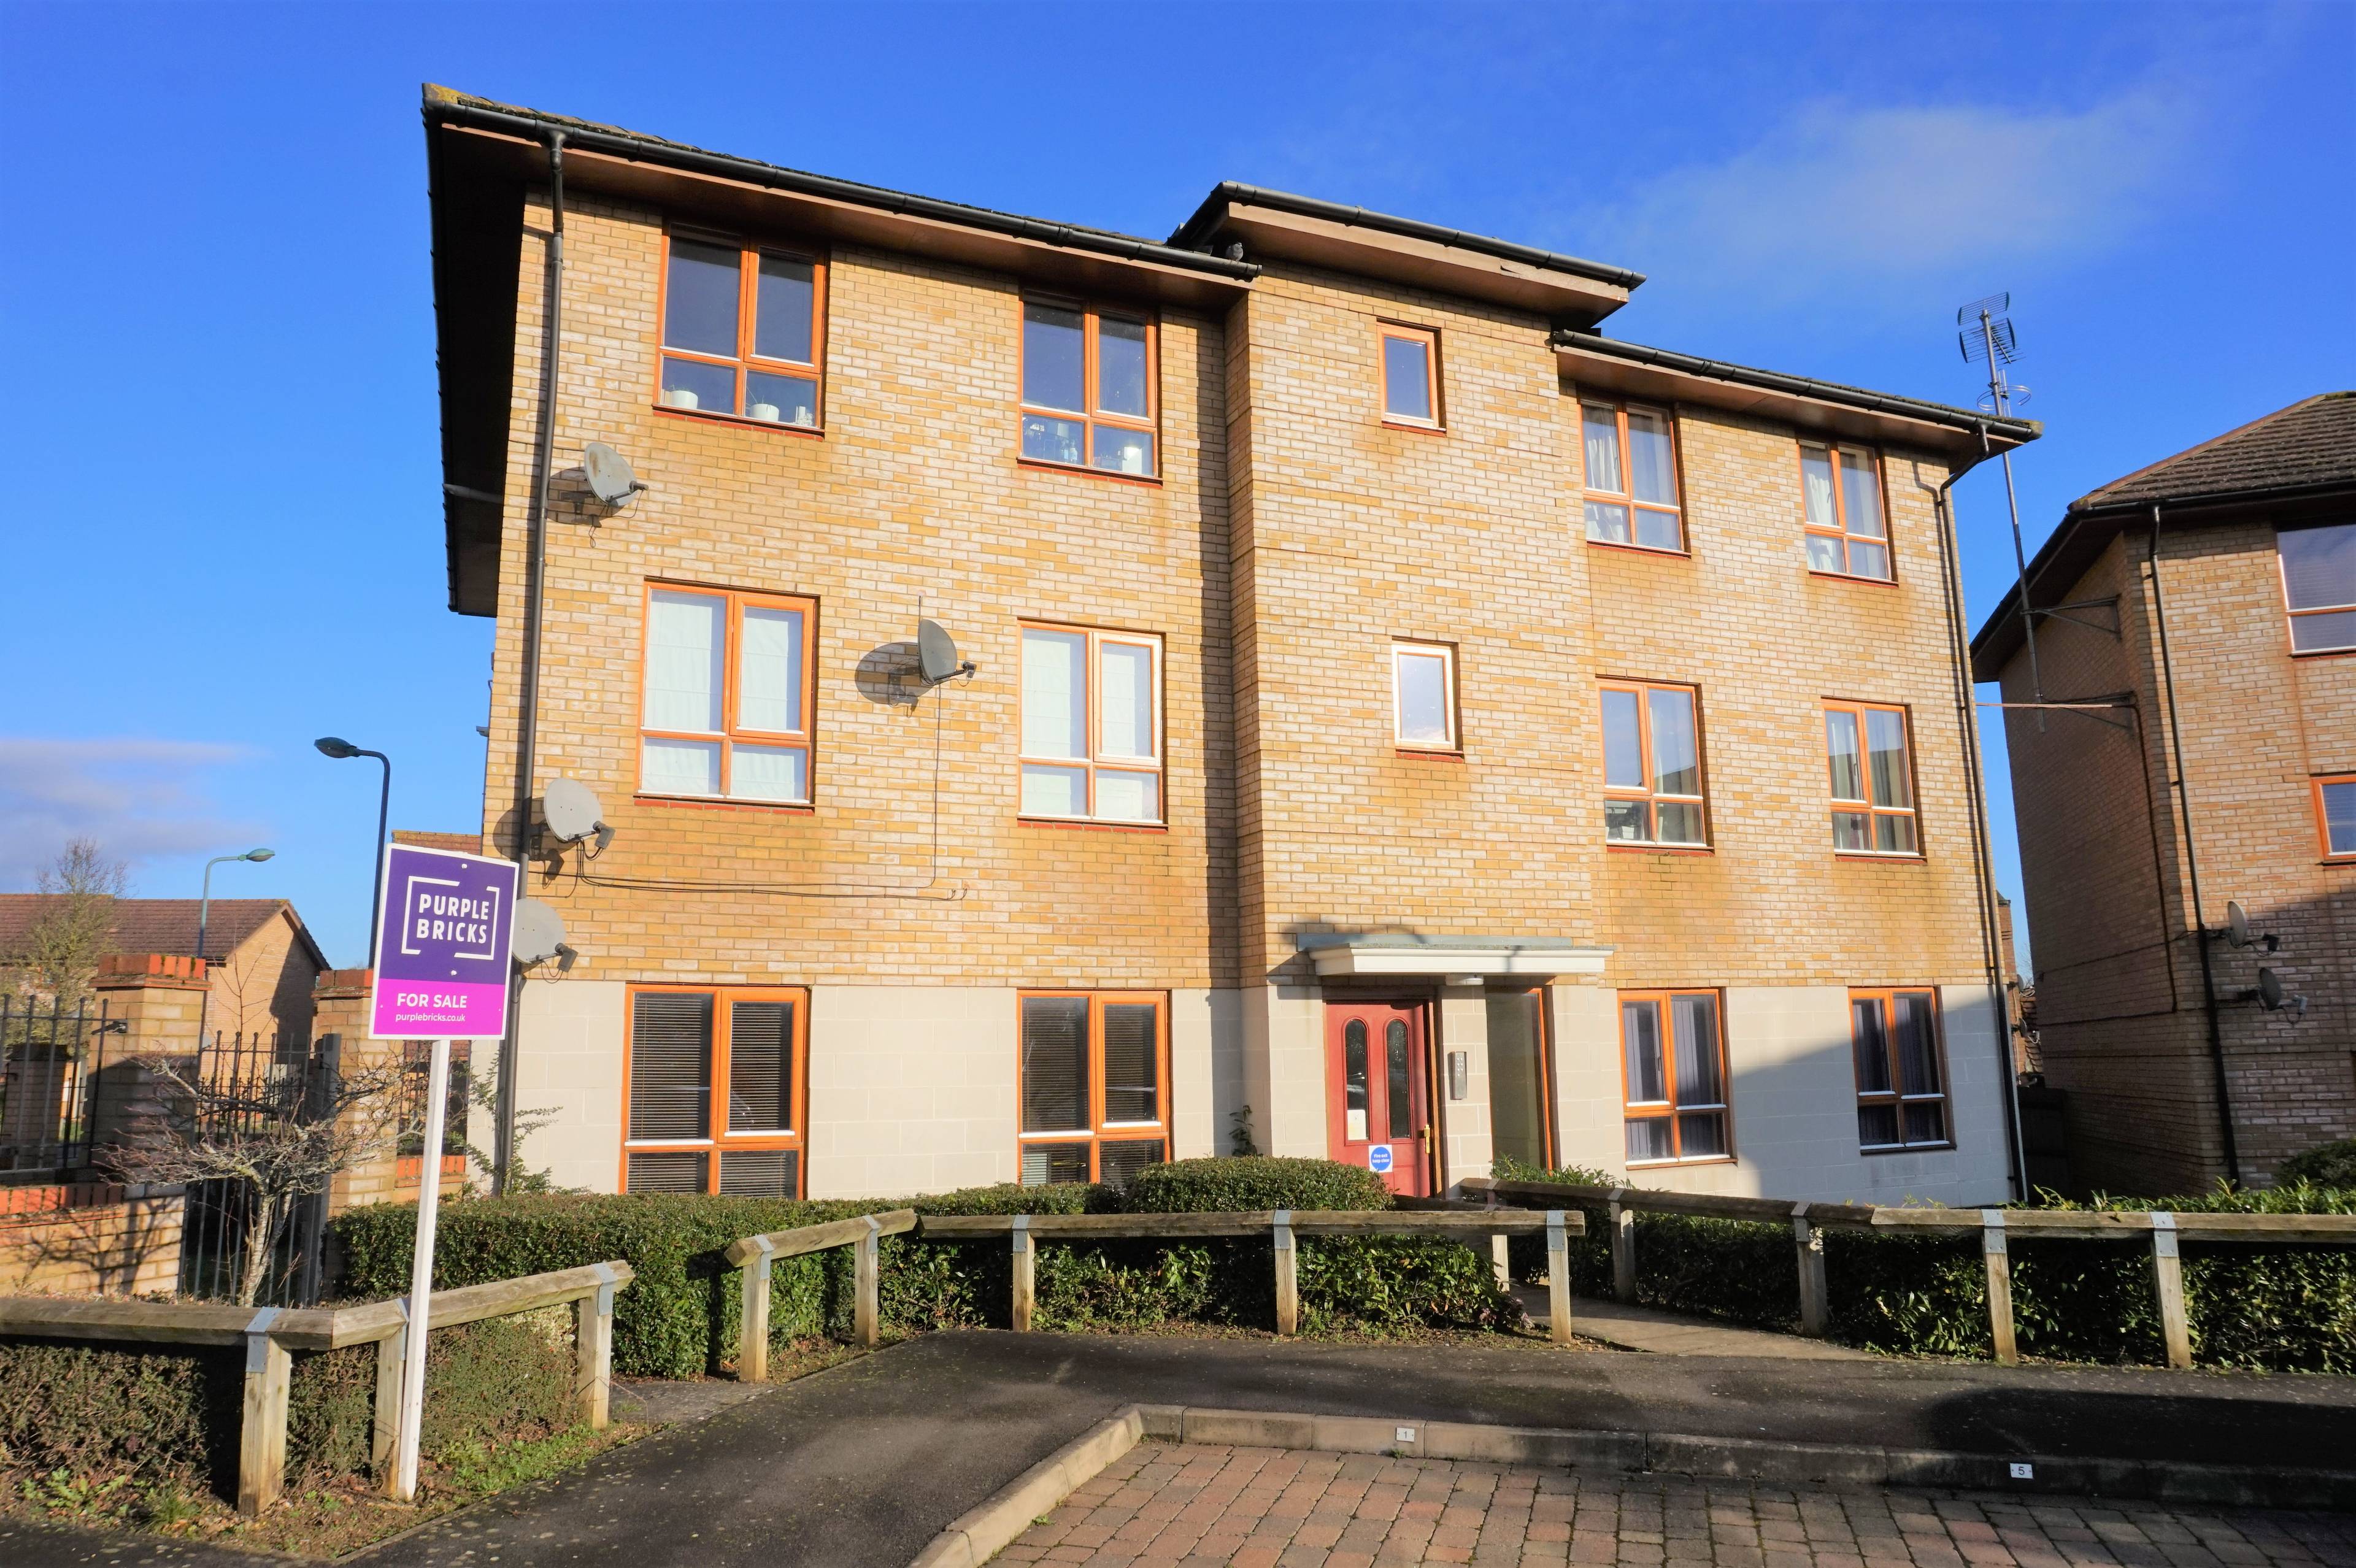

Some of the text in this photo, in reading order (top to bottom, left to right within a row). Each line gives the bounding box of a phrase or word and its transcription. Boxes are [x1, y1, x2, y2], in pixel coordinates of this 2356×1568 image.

[418, 893, 490, 920] PURPLE
[416, 918, 487, 944] BRICKS
[396, 993, 468, 1009] FOR SALE
[395, 1013, 466, 1023] purplebricks.co.uk
[2019, 1466, 2025, 1475] 5
